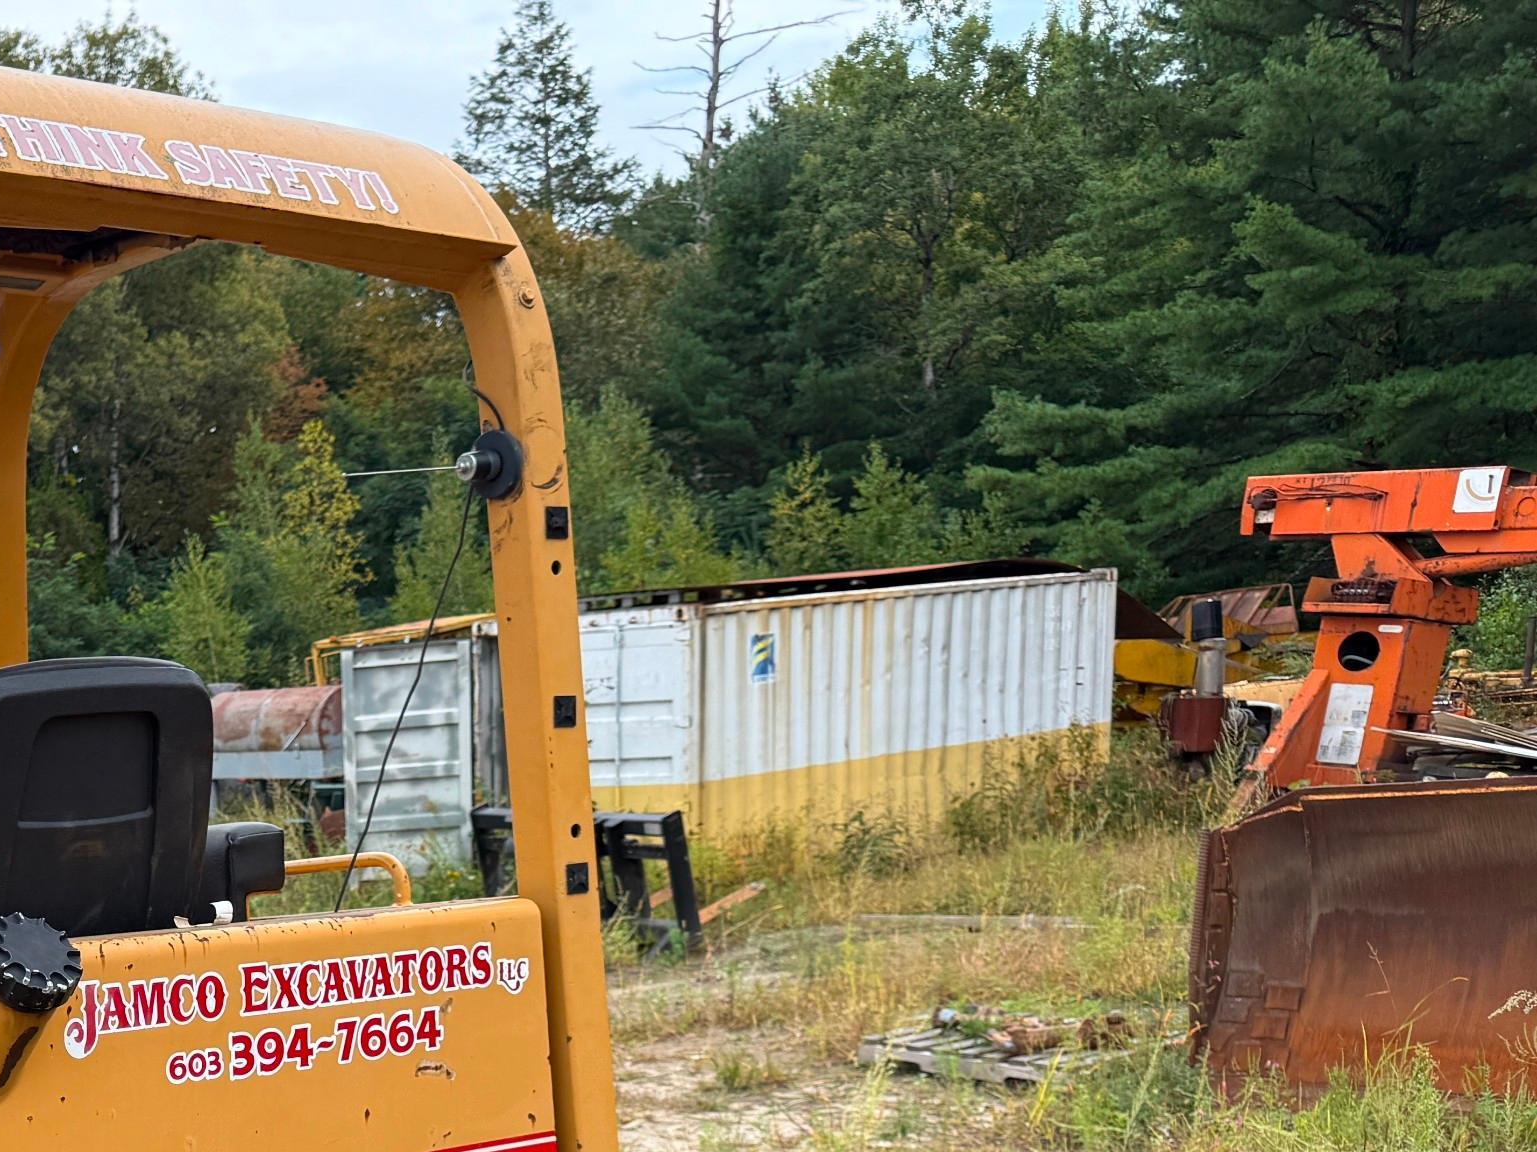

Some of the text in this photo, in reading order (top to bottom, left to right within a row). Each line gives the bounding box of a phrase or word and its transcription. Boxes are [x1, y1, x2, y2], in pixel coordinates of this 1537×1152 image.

[164, 140, 400, 215] SAFETY!
[66, 943, 529, 1057] JAMCO EXCAVATORS LLC
[168, 1048, 223, 1083] 603
